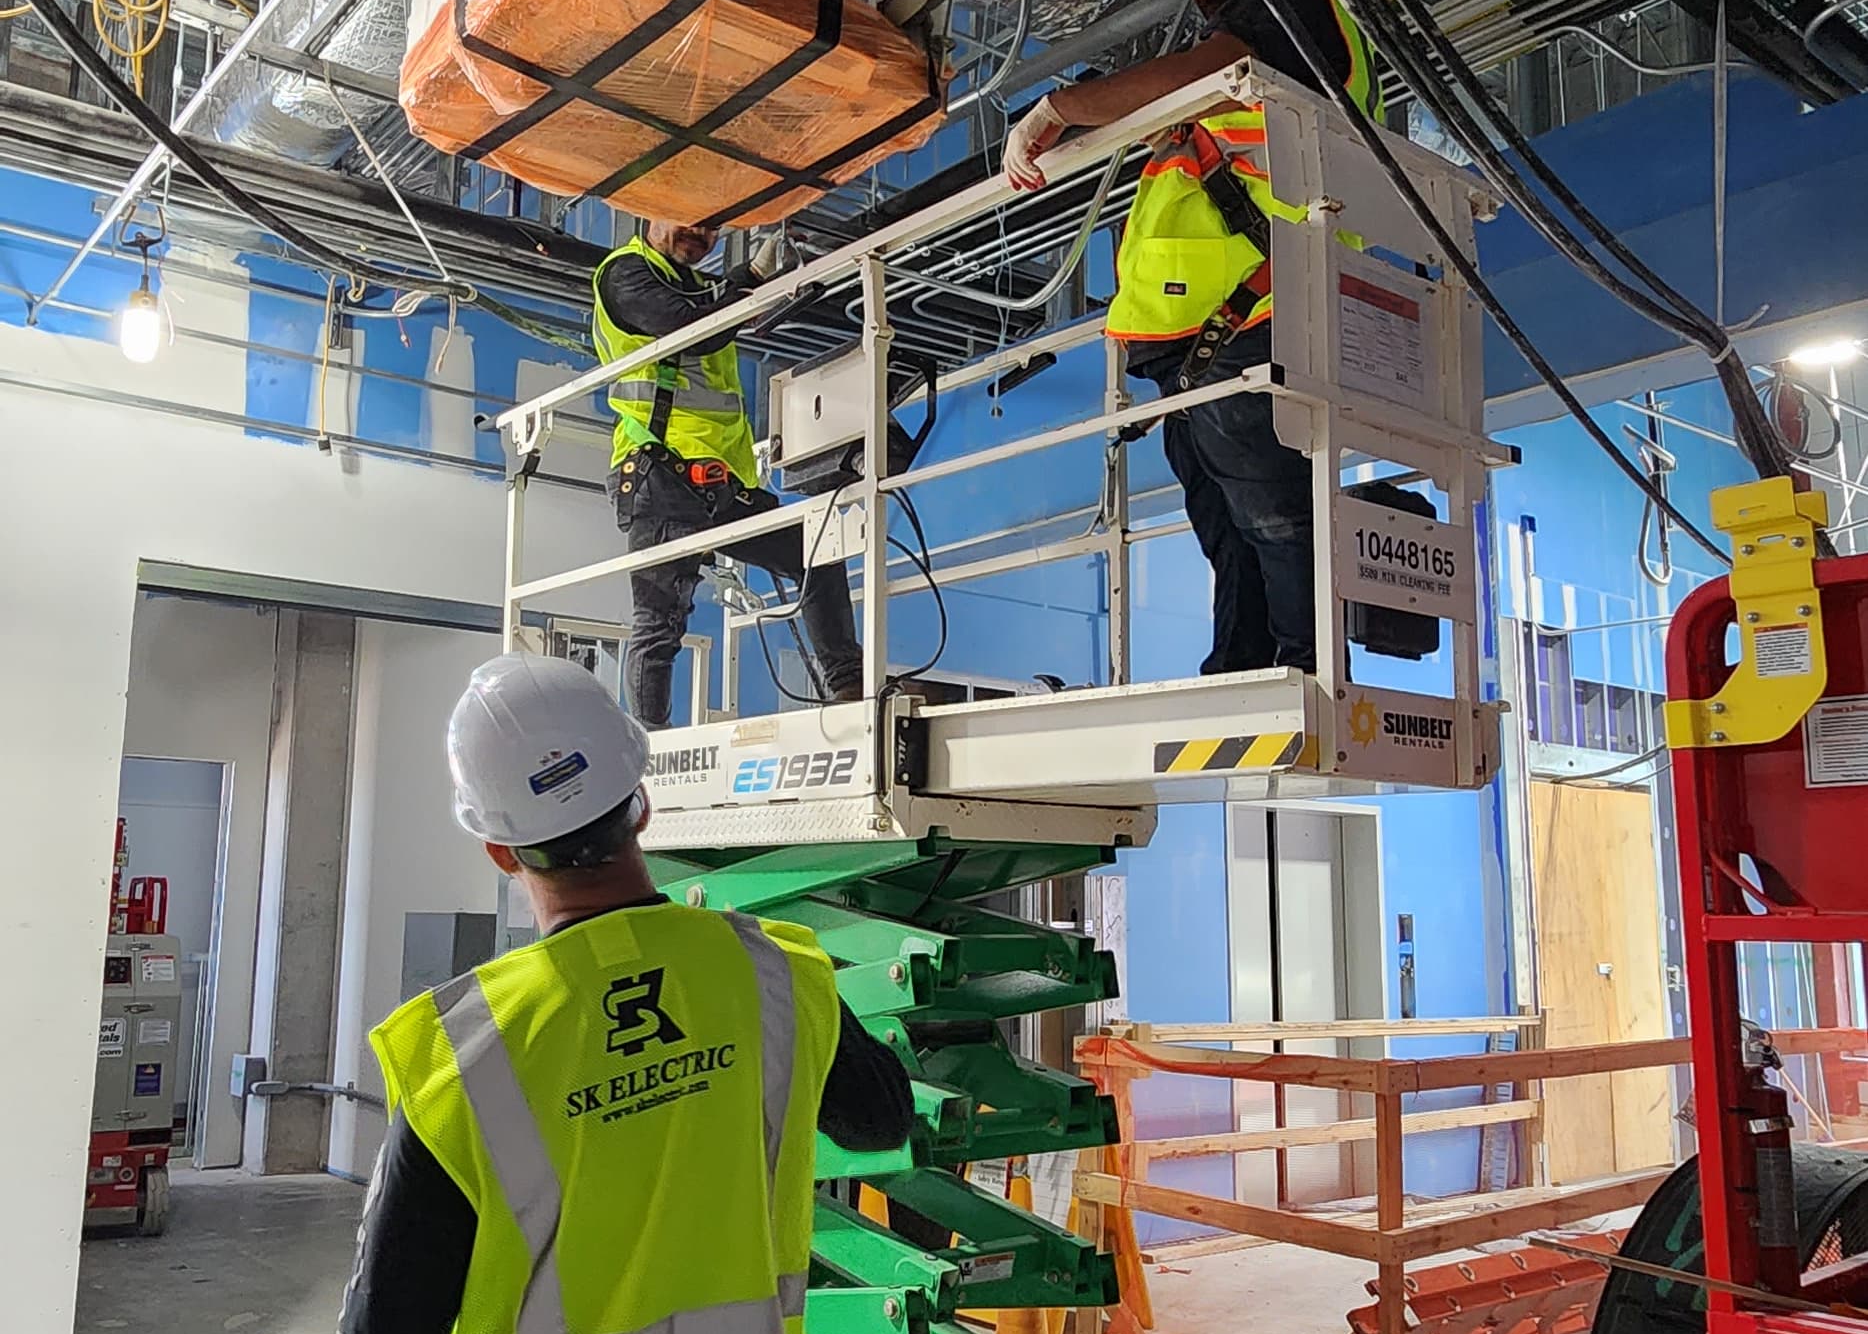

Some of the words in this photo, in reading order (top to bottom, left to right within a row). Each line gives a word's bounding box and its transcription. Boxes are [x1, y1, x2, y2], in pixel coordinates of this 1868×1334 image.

[1355, 528, 1455, 578] 10448165
[1382, 569, 1396, 584] MIN
[1438, 582, 1451, 596] FEE
[1383, 711, 1453, 740] SUNBELT
[1393, 735, 1445, 750] RENTALS
[645, 745, 720, 778] SUNBELT
[732, 749, 859, 795] ES1932
[653, 772, 708, 788] RENTALS
[566, 1082, 605, 1119] SK
[607, 1043, 737, 1104] ELECTRIC
